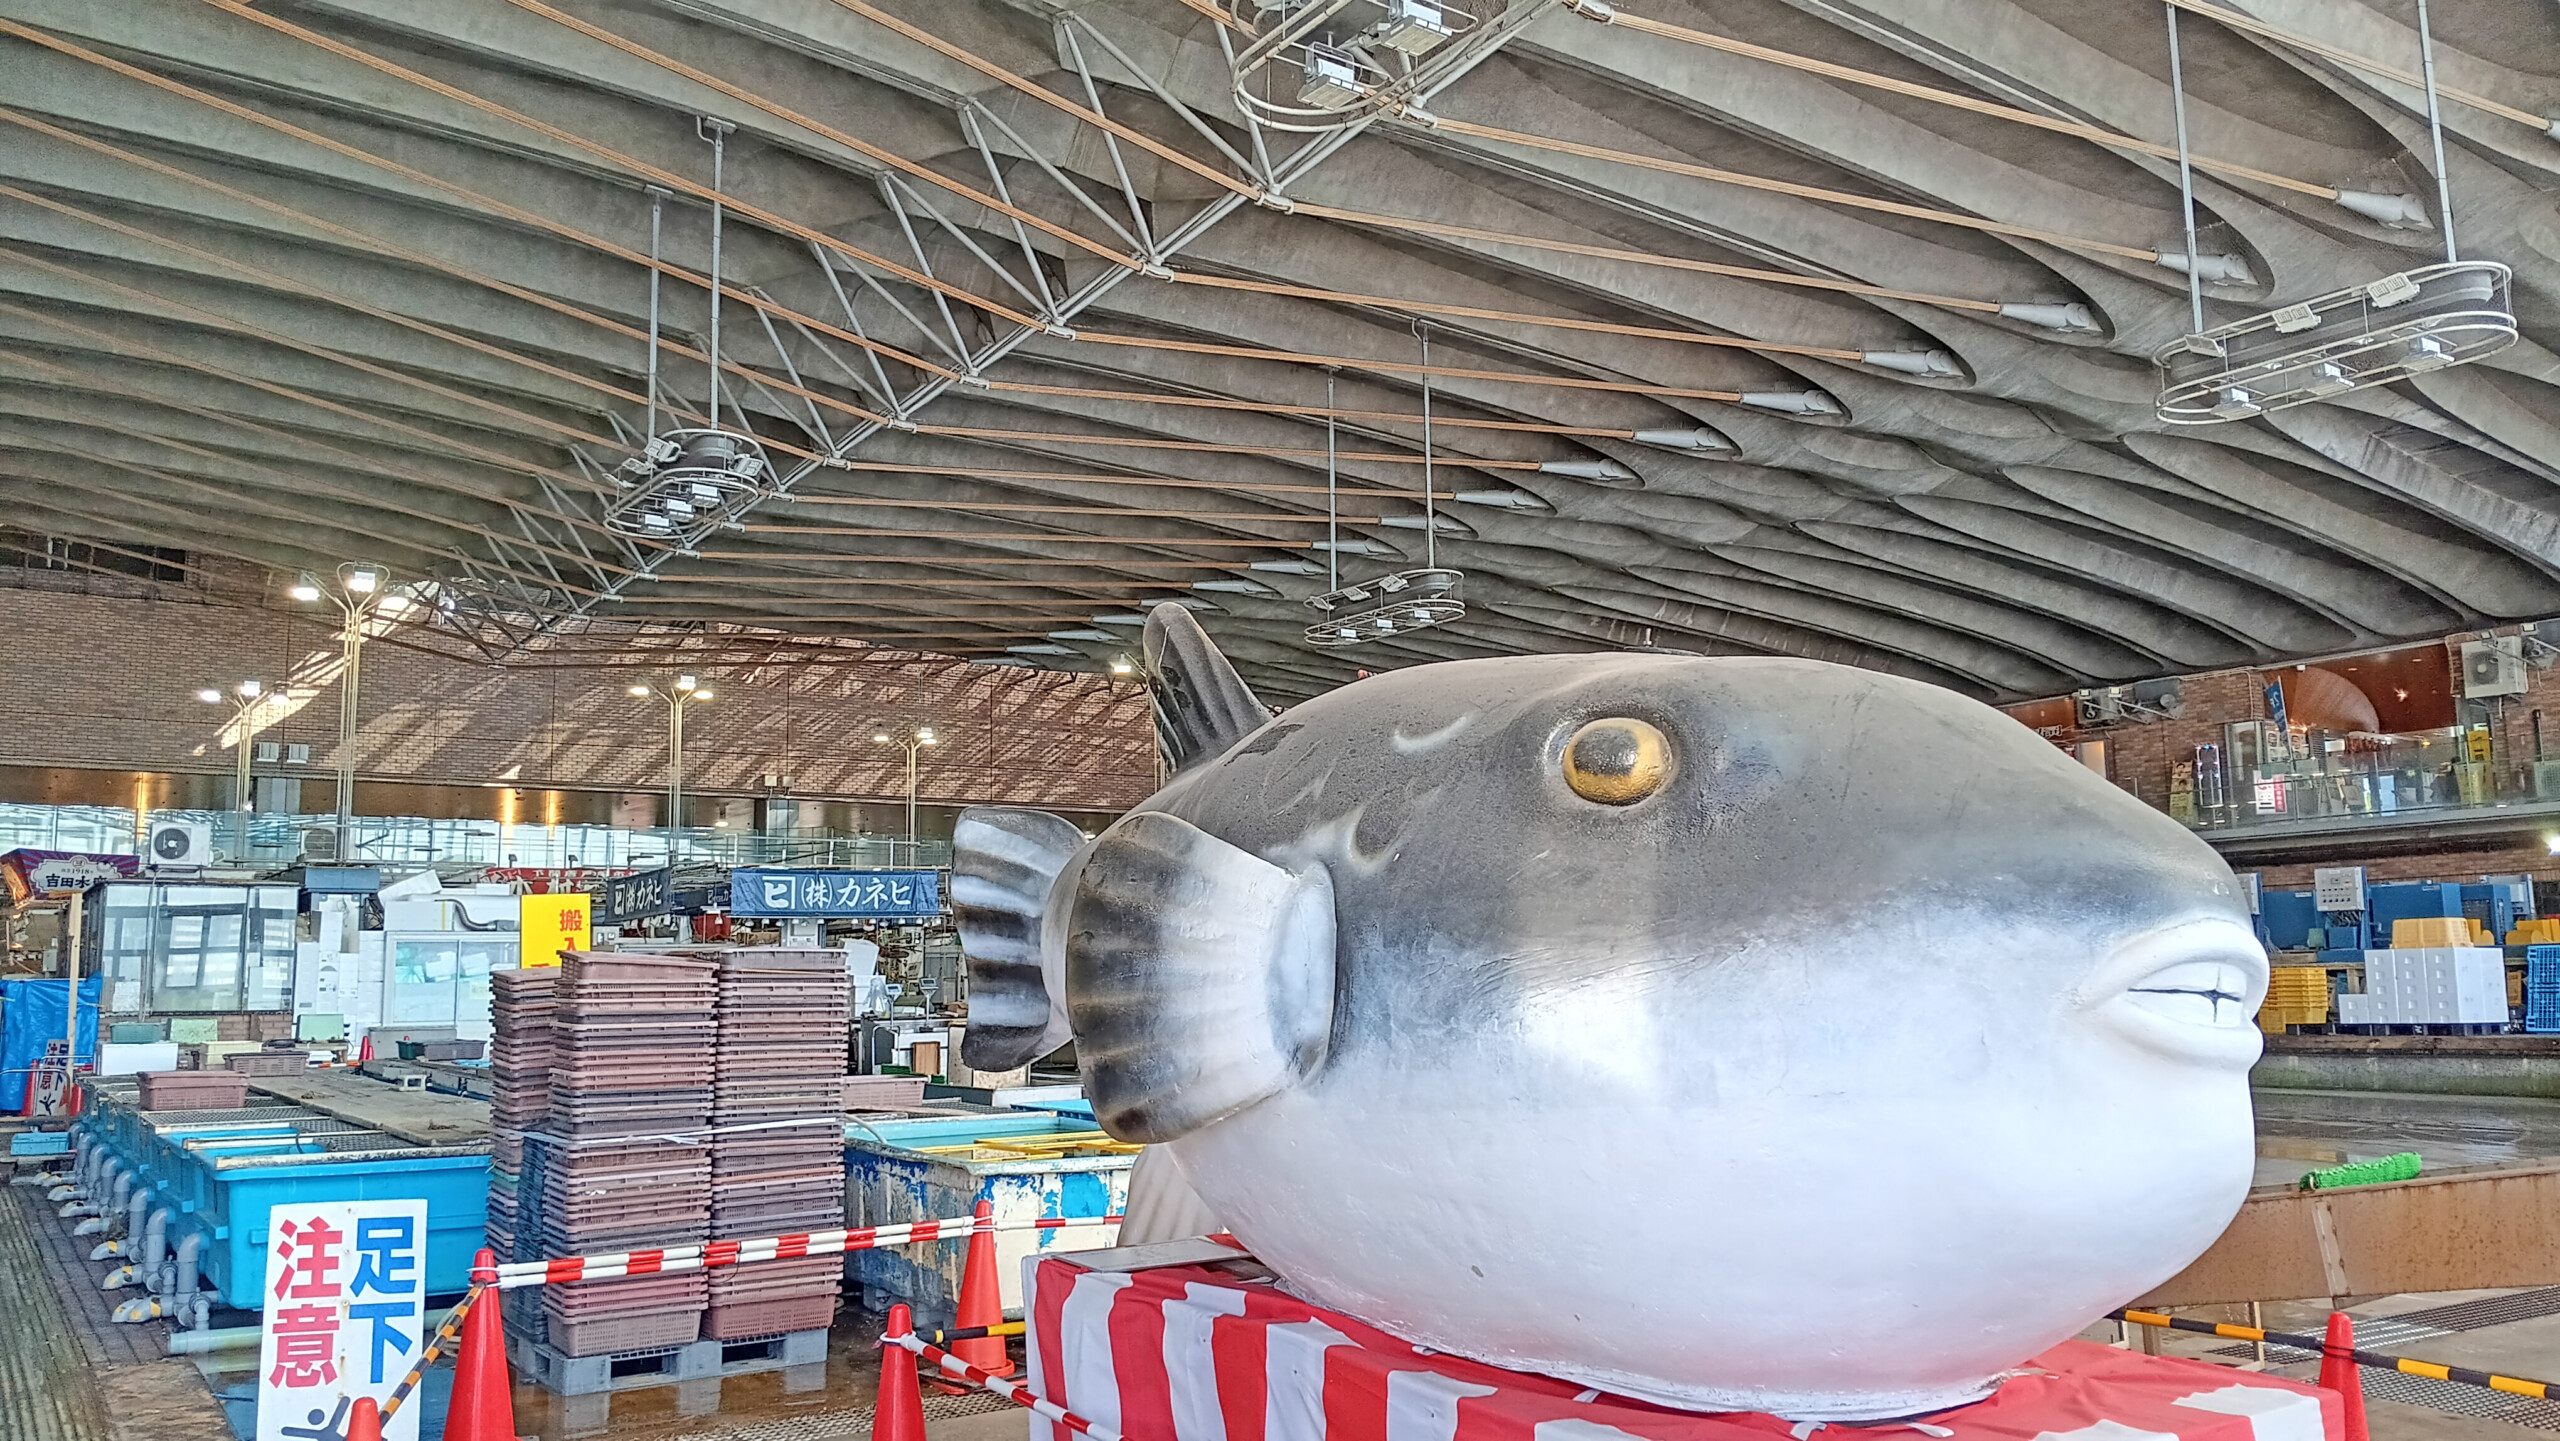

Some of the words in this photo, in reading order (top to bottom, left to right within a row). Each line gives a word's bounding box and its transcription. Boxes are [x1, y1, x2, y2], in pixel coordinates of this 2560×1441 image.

[801, 876, 912, 910] (株)カネヒ
[269, 1216, 343, 1389] 注意
[349, 1216, 417, 1384] 足下
